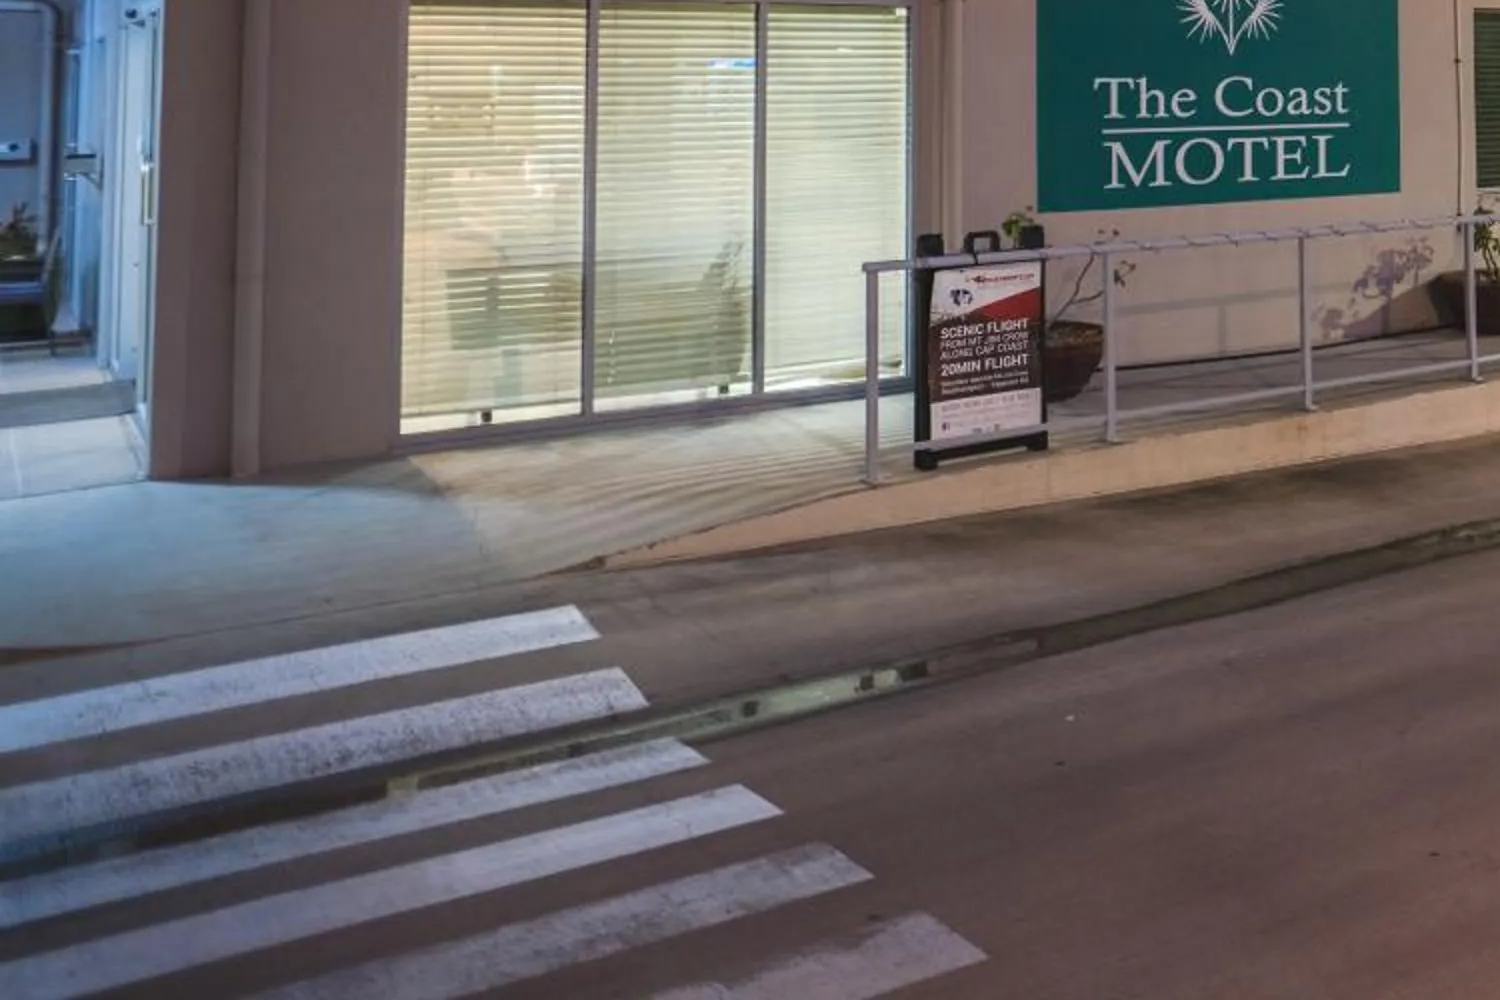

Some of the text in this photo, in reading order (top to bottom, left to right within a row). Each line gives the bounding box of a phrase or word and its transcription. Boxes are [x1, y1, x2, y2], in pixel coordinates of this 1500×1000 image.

[1093, 75, 1350, 119] The Coast
[1103, 134, 1351, 189] MOTEL
[940, 318, 1029, 339] SCENIC FLIGHT
[940, 338, 967, 350] FROM
[967, 336, 983, 346] MT
[940, 346, 974, 360] ALONG
[996, 340, 1029, 353] COAST
[940, 353, 1029, 377] 20MIN FLIGHT
